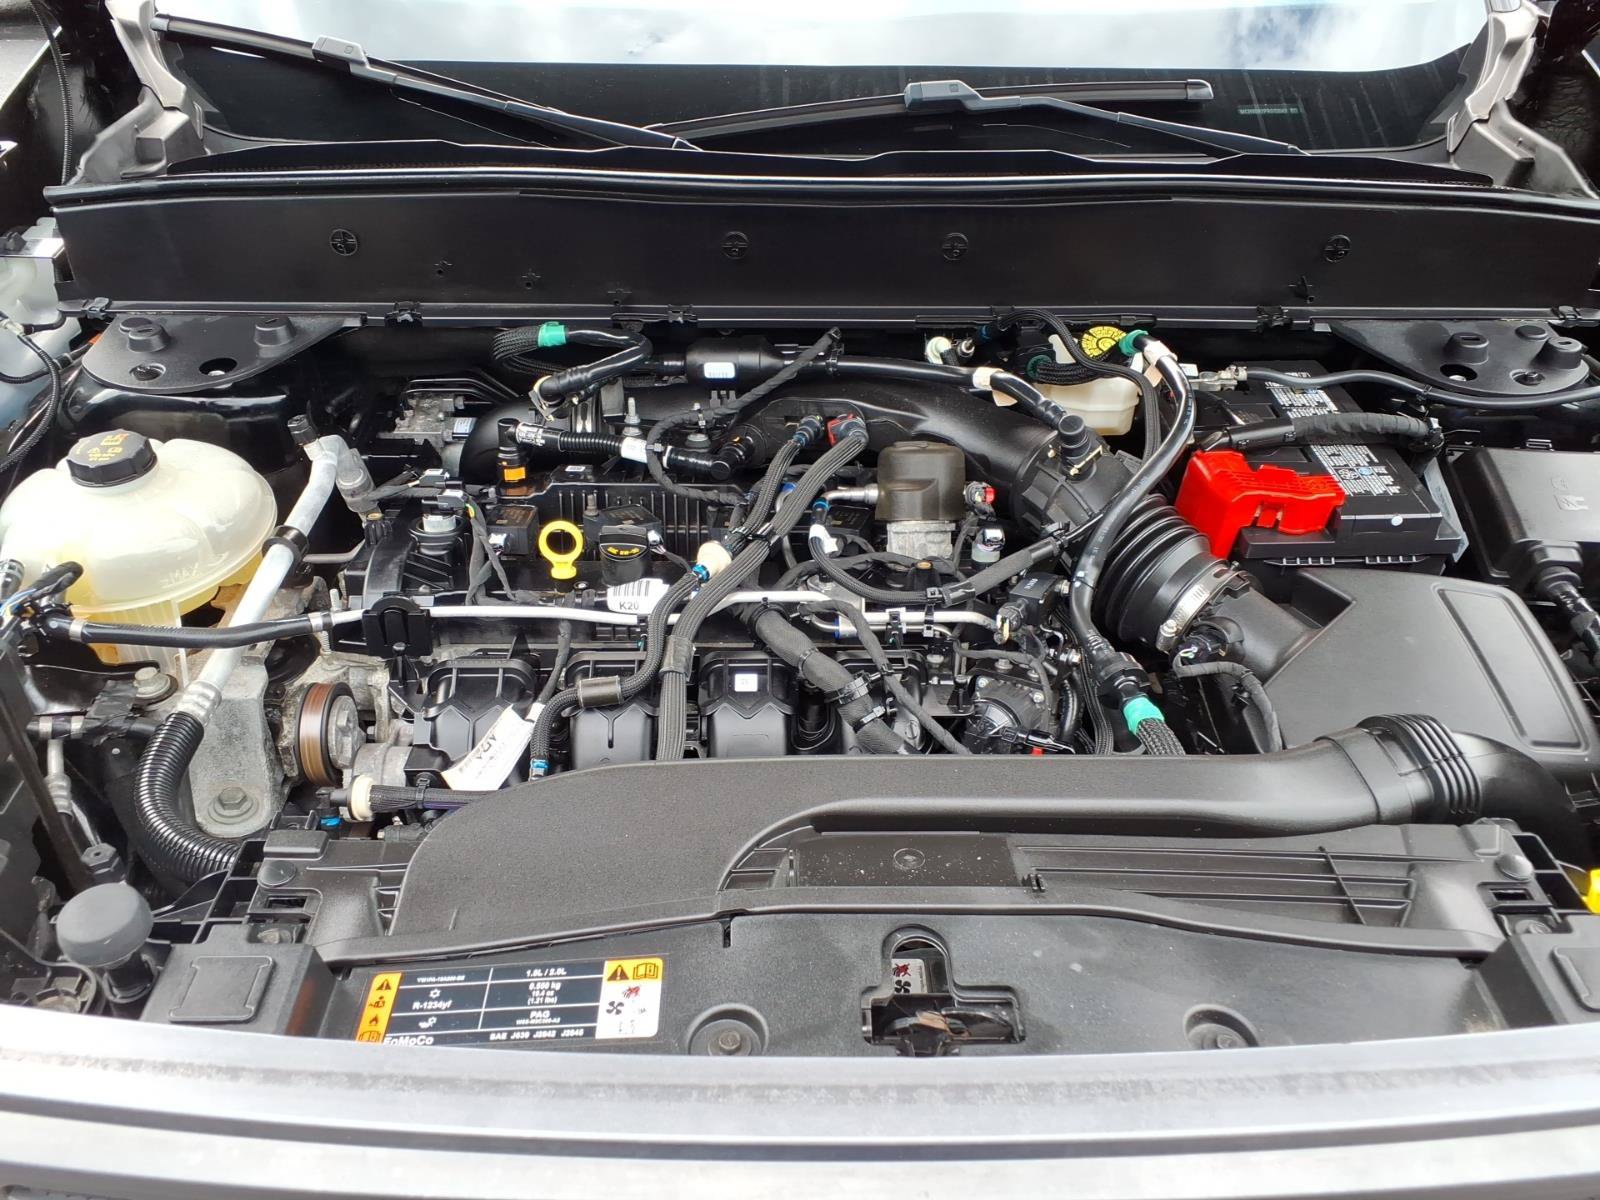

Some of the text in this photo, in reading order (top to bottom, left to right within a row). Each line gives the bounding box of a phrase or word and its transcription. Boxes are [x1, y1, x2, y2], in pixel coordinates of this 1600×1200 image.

[619, 601, 639, 610] K20
[551, 981, 562, 991] kg
[412, 1000, 452, 1010] R-1234yf
[529, 1009, 551, 1019] PAG
[489, 1032, 508, 1041] SAE
